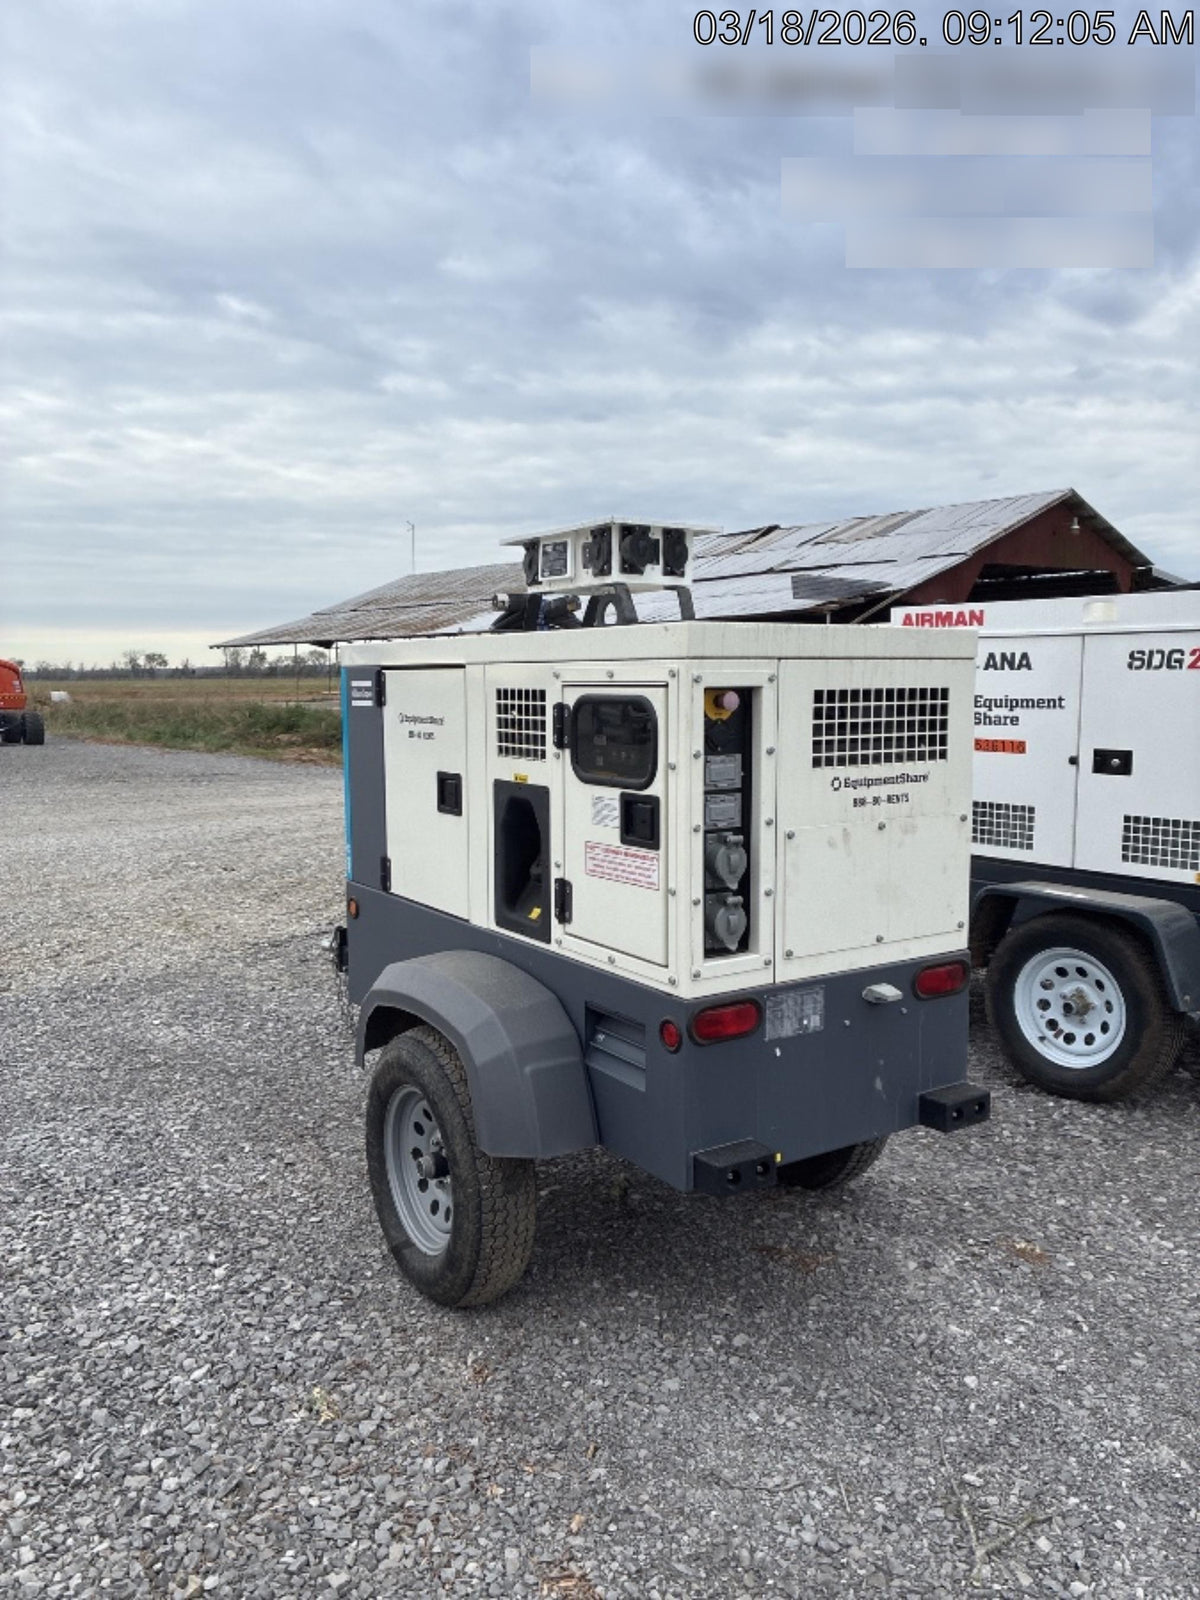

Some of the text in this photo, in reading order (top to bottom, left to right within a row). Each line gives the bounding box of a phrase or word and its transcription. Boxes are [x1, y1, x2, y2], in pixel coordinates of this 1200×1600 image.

[902, 609, 984, 628] AIRMAN
[983, 651, 1032, 671] ANA
[974, 694, 1066, 712] Equipment
[974, 711, 1020, 726] Share
[843, 773, 929, 789] EquipmentShare
